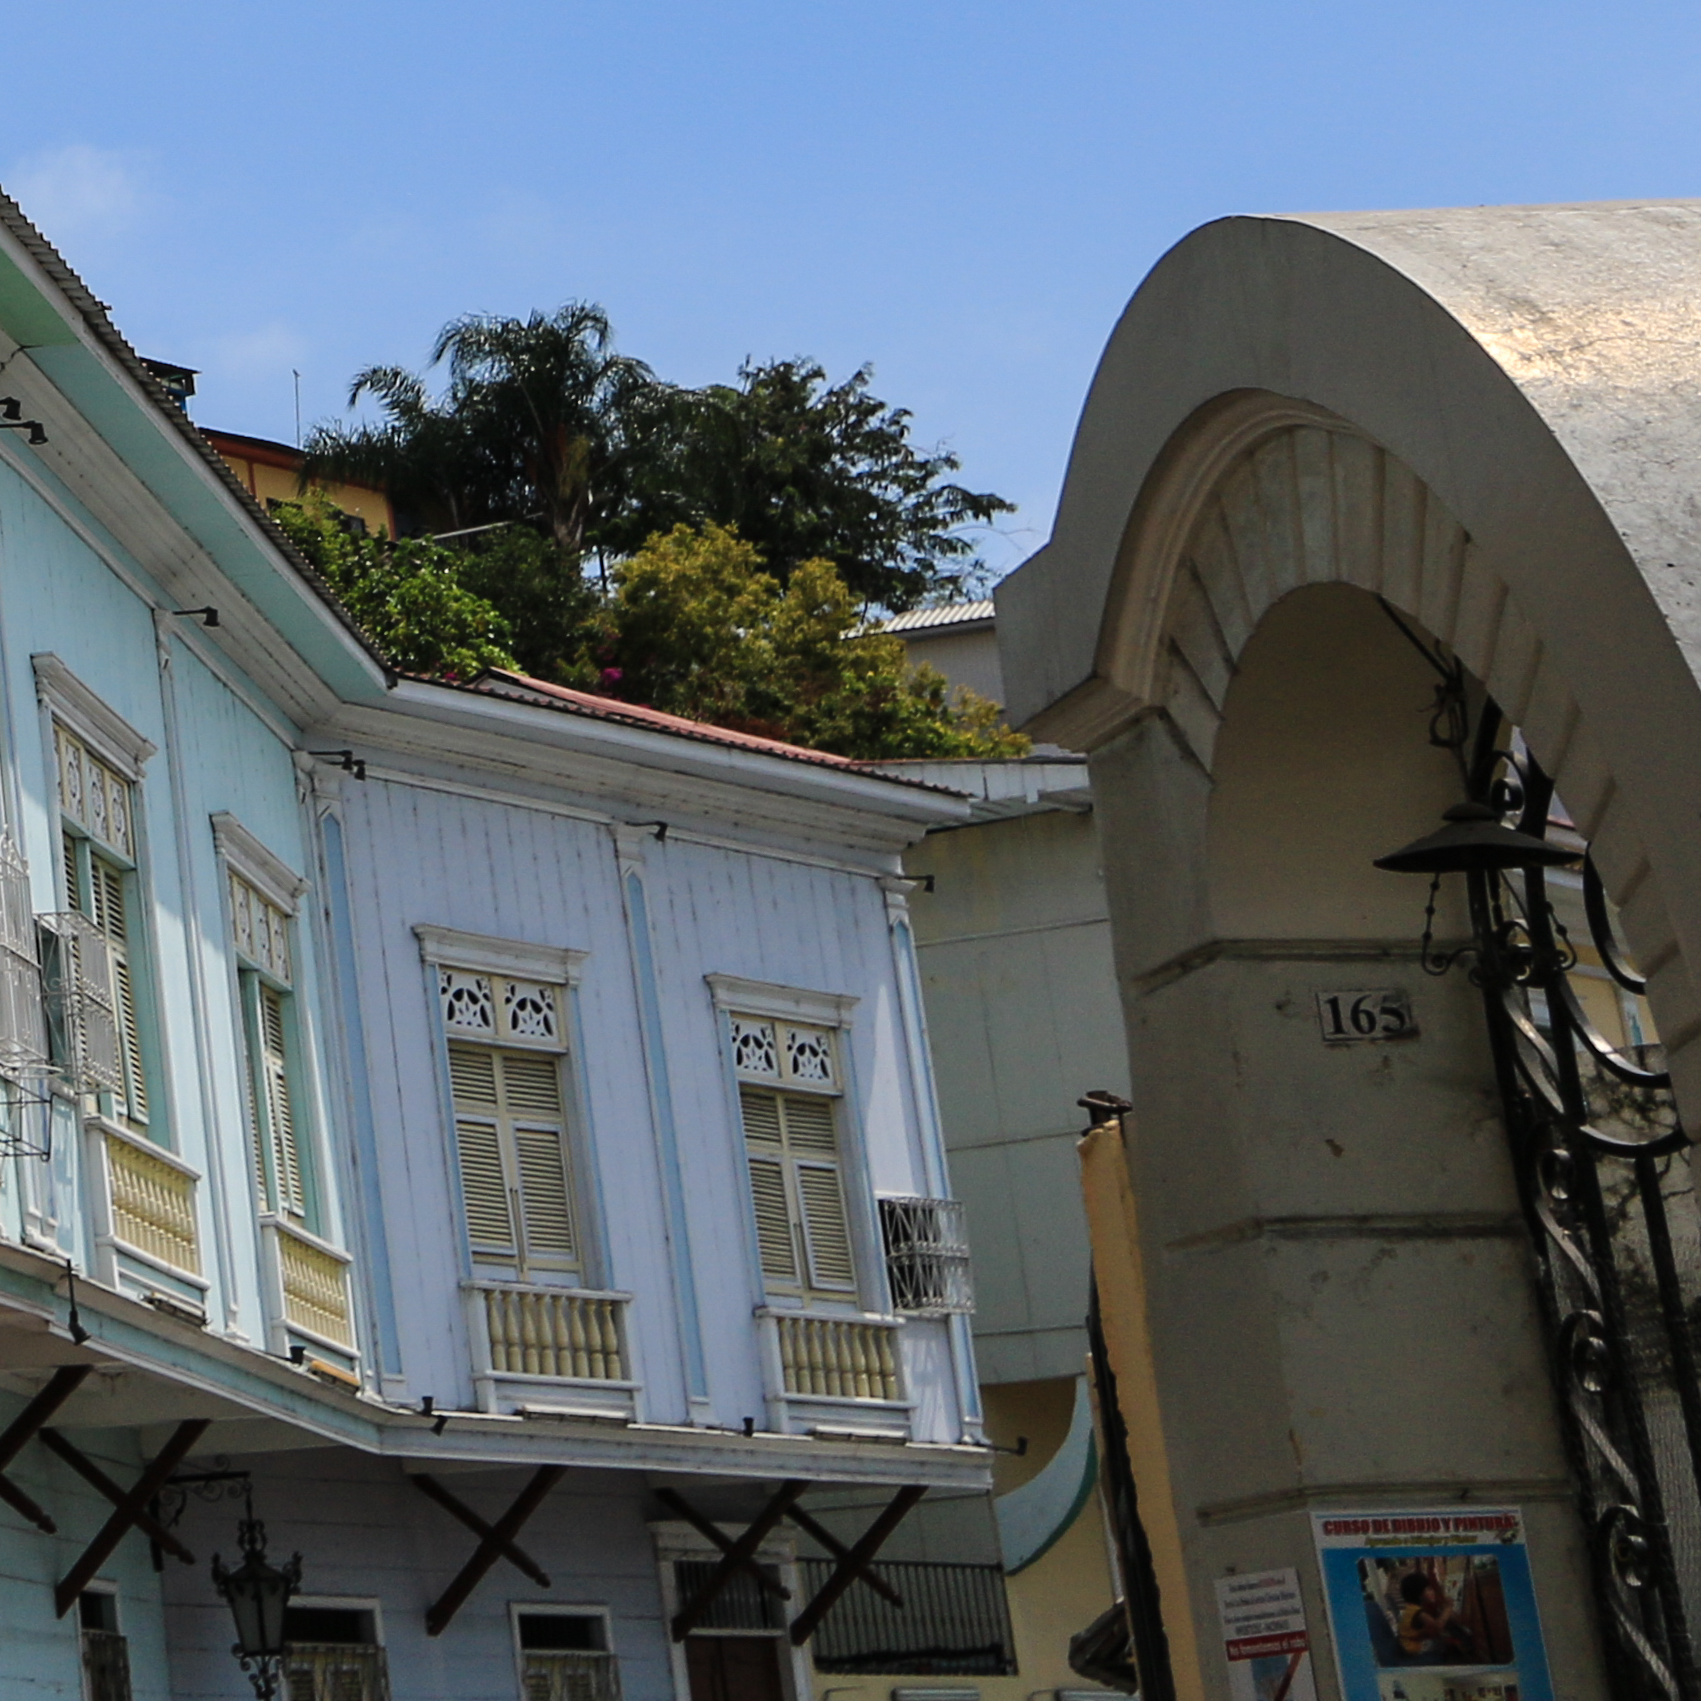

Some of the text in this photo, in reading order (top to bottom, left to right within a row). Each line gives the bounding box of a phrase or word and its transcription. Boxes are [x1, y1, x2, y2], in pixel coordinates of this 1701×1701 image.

[1324, 994, 1405, 1034] 165
[1323, 1520, 1371, 1536] CURSO
[1371, 1518, 1390, 1535] DE
[1391, 1517, 1440, 1534] DIBUJO
[1441, 1516, 1451, 1533] Y
